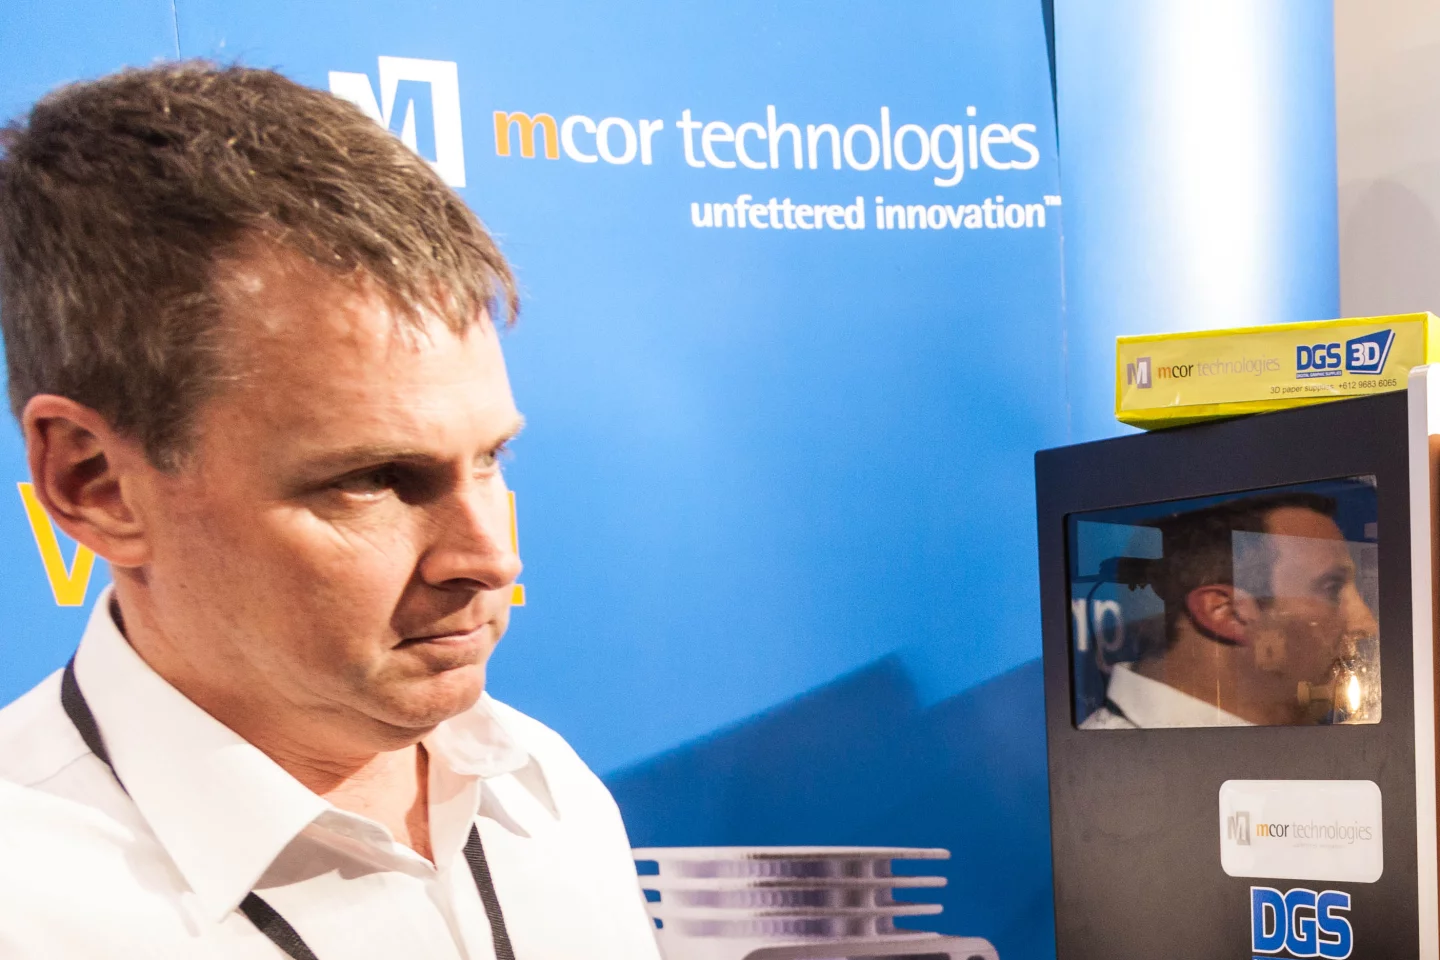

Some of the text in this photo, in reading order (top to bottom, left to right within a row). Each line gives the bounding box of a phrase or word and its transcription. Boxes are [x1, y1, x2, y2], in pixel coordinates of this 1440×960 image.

[494, 108, 663, 165] mcor
[677, 105, 1041, 187] technologies
[692, 194, 865, 230] unfettered
[1157, 364, 1194, 380] mcor
[1197, 354, 1281, 376] technologies
[1296, 341, 1380, 371] DGS 3D
[1270, 386, 1280, 394] 3D
[1282, 386, 1303, 395] paper
[1338, 380, 1357, 390] +612
[1358, 379, 1377, 389] 9683
[1256, 822, 1290, 838] mcor
[1293, 820, 1373, 845] technologies
[1250, 886, 1354, 960] DGS
